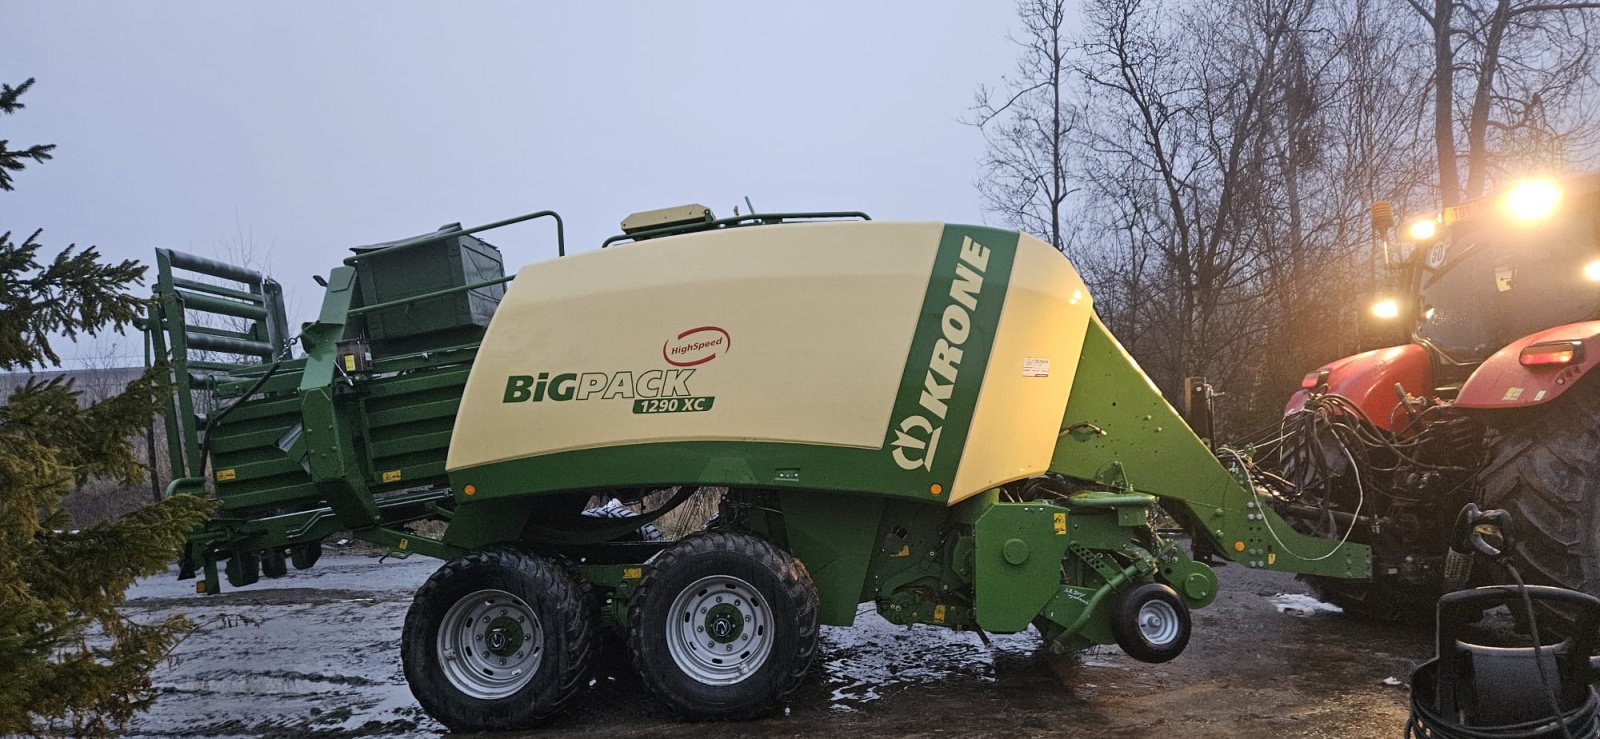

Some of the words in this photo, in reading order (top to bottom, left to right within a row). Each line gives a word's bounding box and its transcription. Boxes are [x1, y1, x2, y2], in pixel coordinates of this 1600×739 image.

[919, 235, 991, 420] KRONE
[671, 336, 723, 355] HighSpeed
[640, 399, 678, 413] 1290
[681, 397, 706, 411] XC
